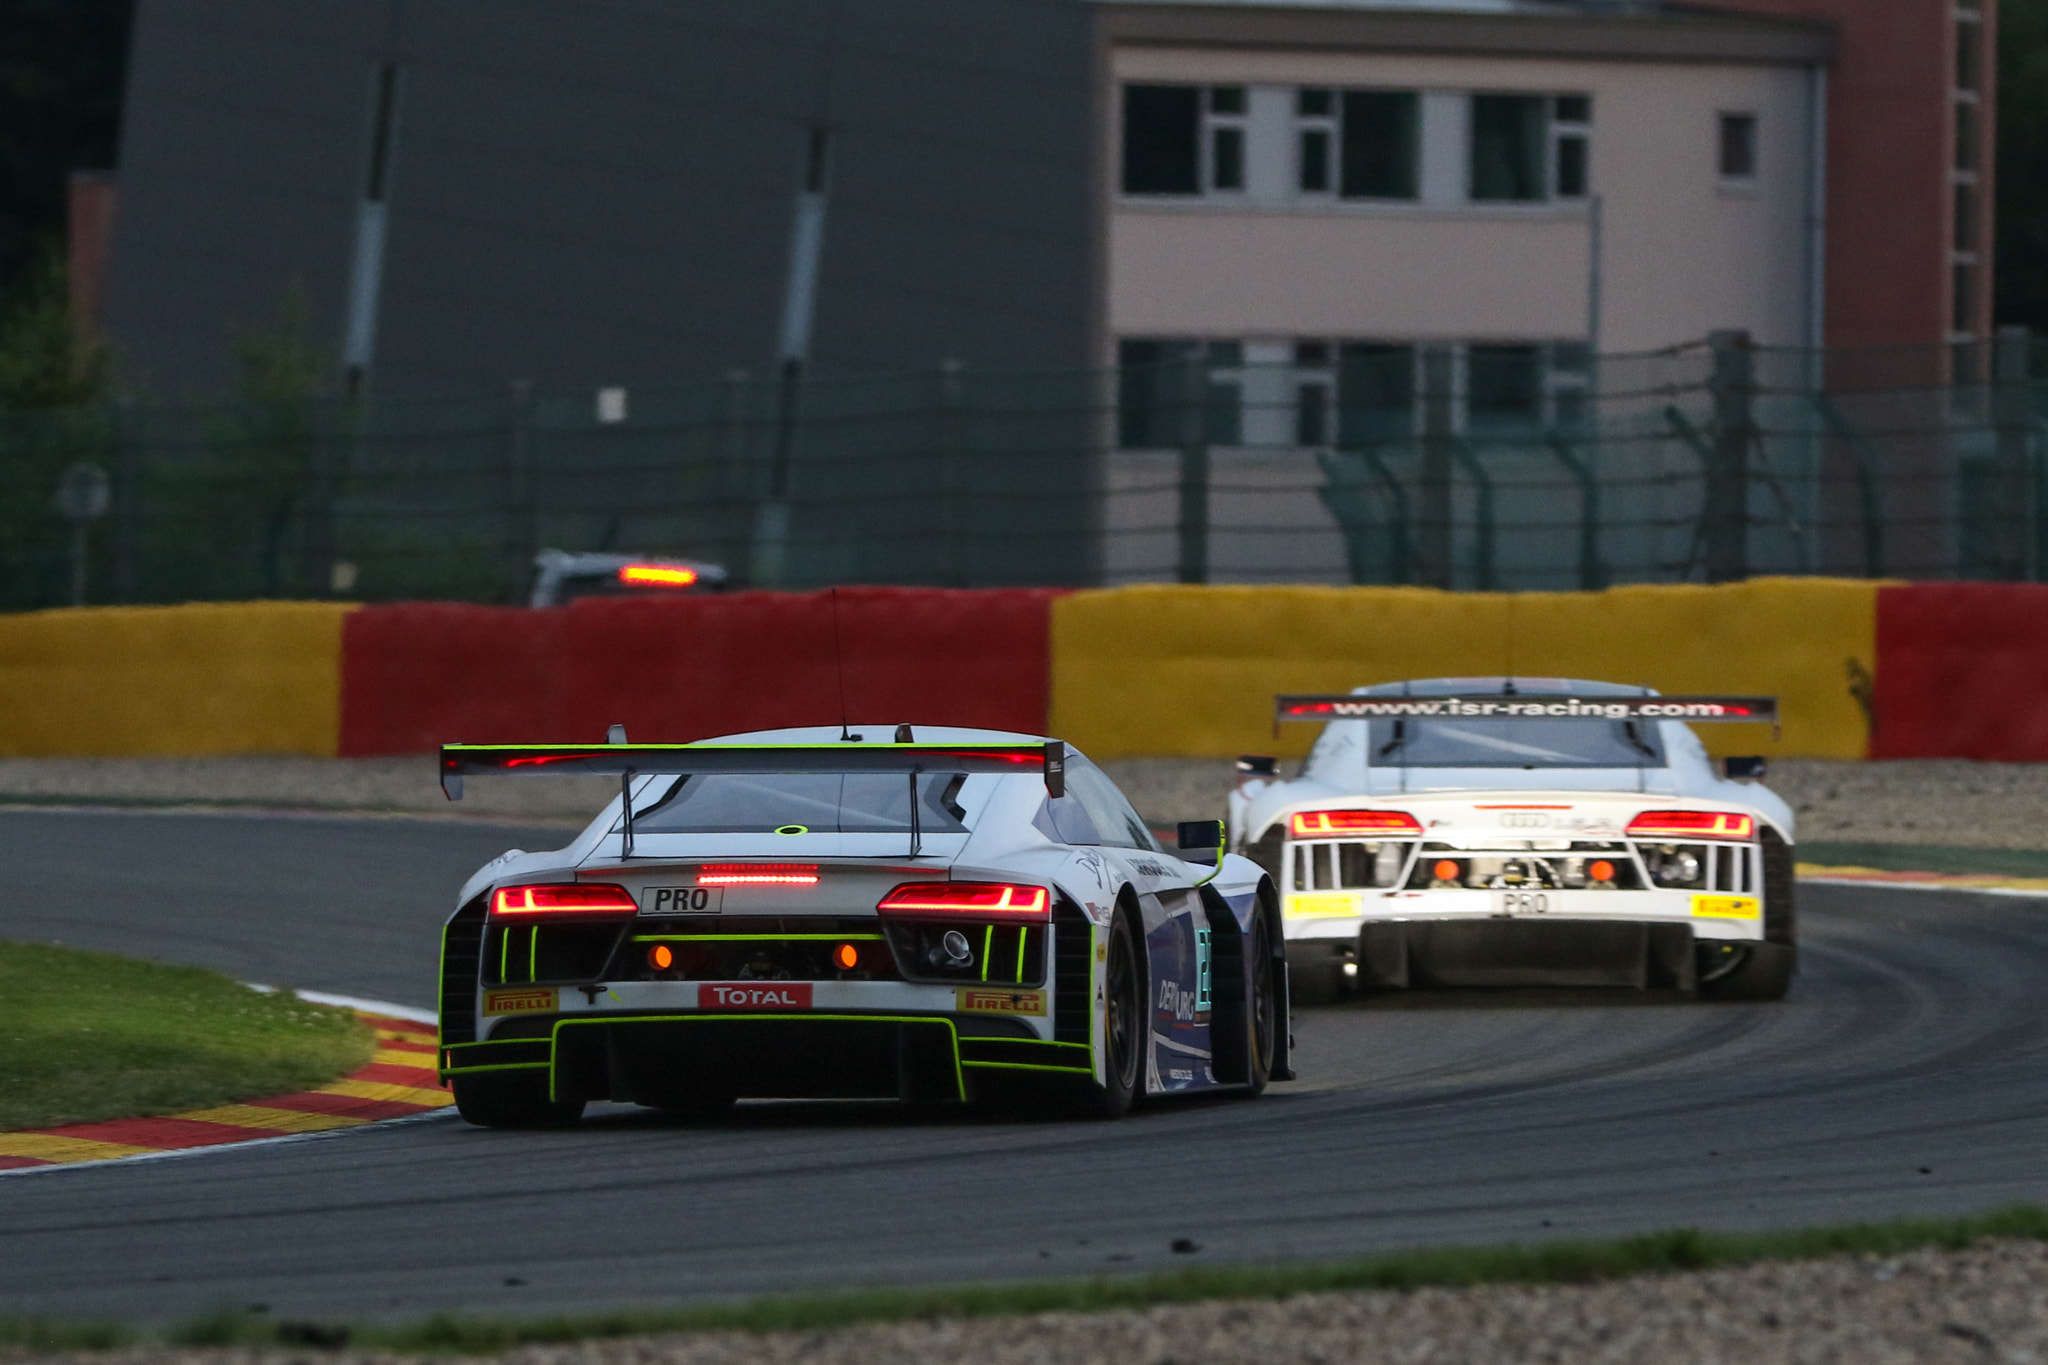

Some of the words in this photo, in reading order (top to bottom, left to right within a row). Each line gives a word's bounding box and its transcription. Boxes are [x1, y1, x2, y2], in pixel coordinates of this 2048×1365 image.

[1332, 698, 1724, 719] www.isr-racing.com
[655, 888, 709, 911] PRO
[488, 991, 552, 1012] PIRELLI
[713, 987, 797, 1005] TOTAL
[965, 991, 1040, 1012] PIRELLI
